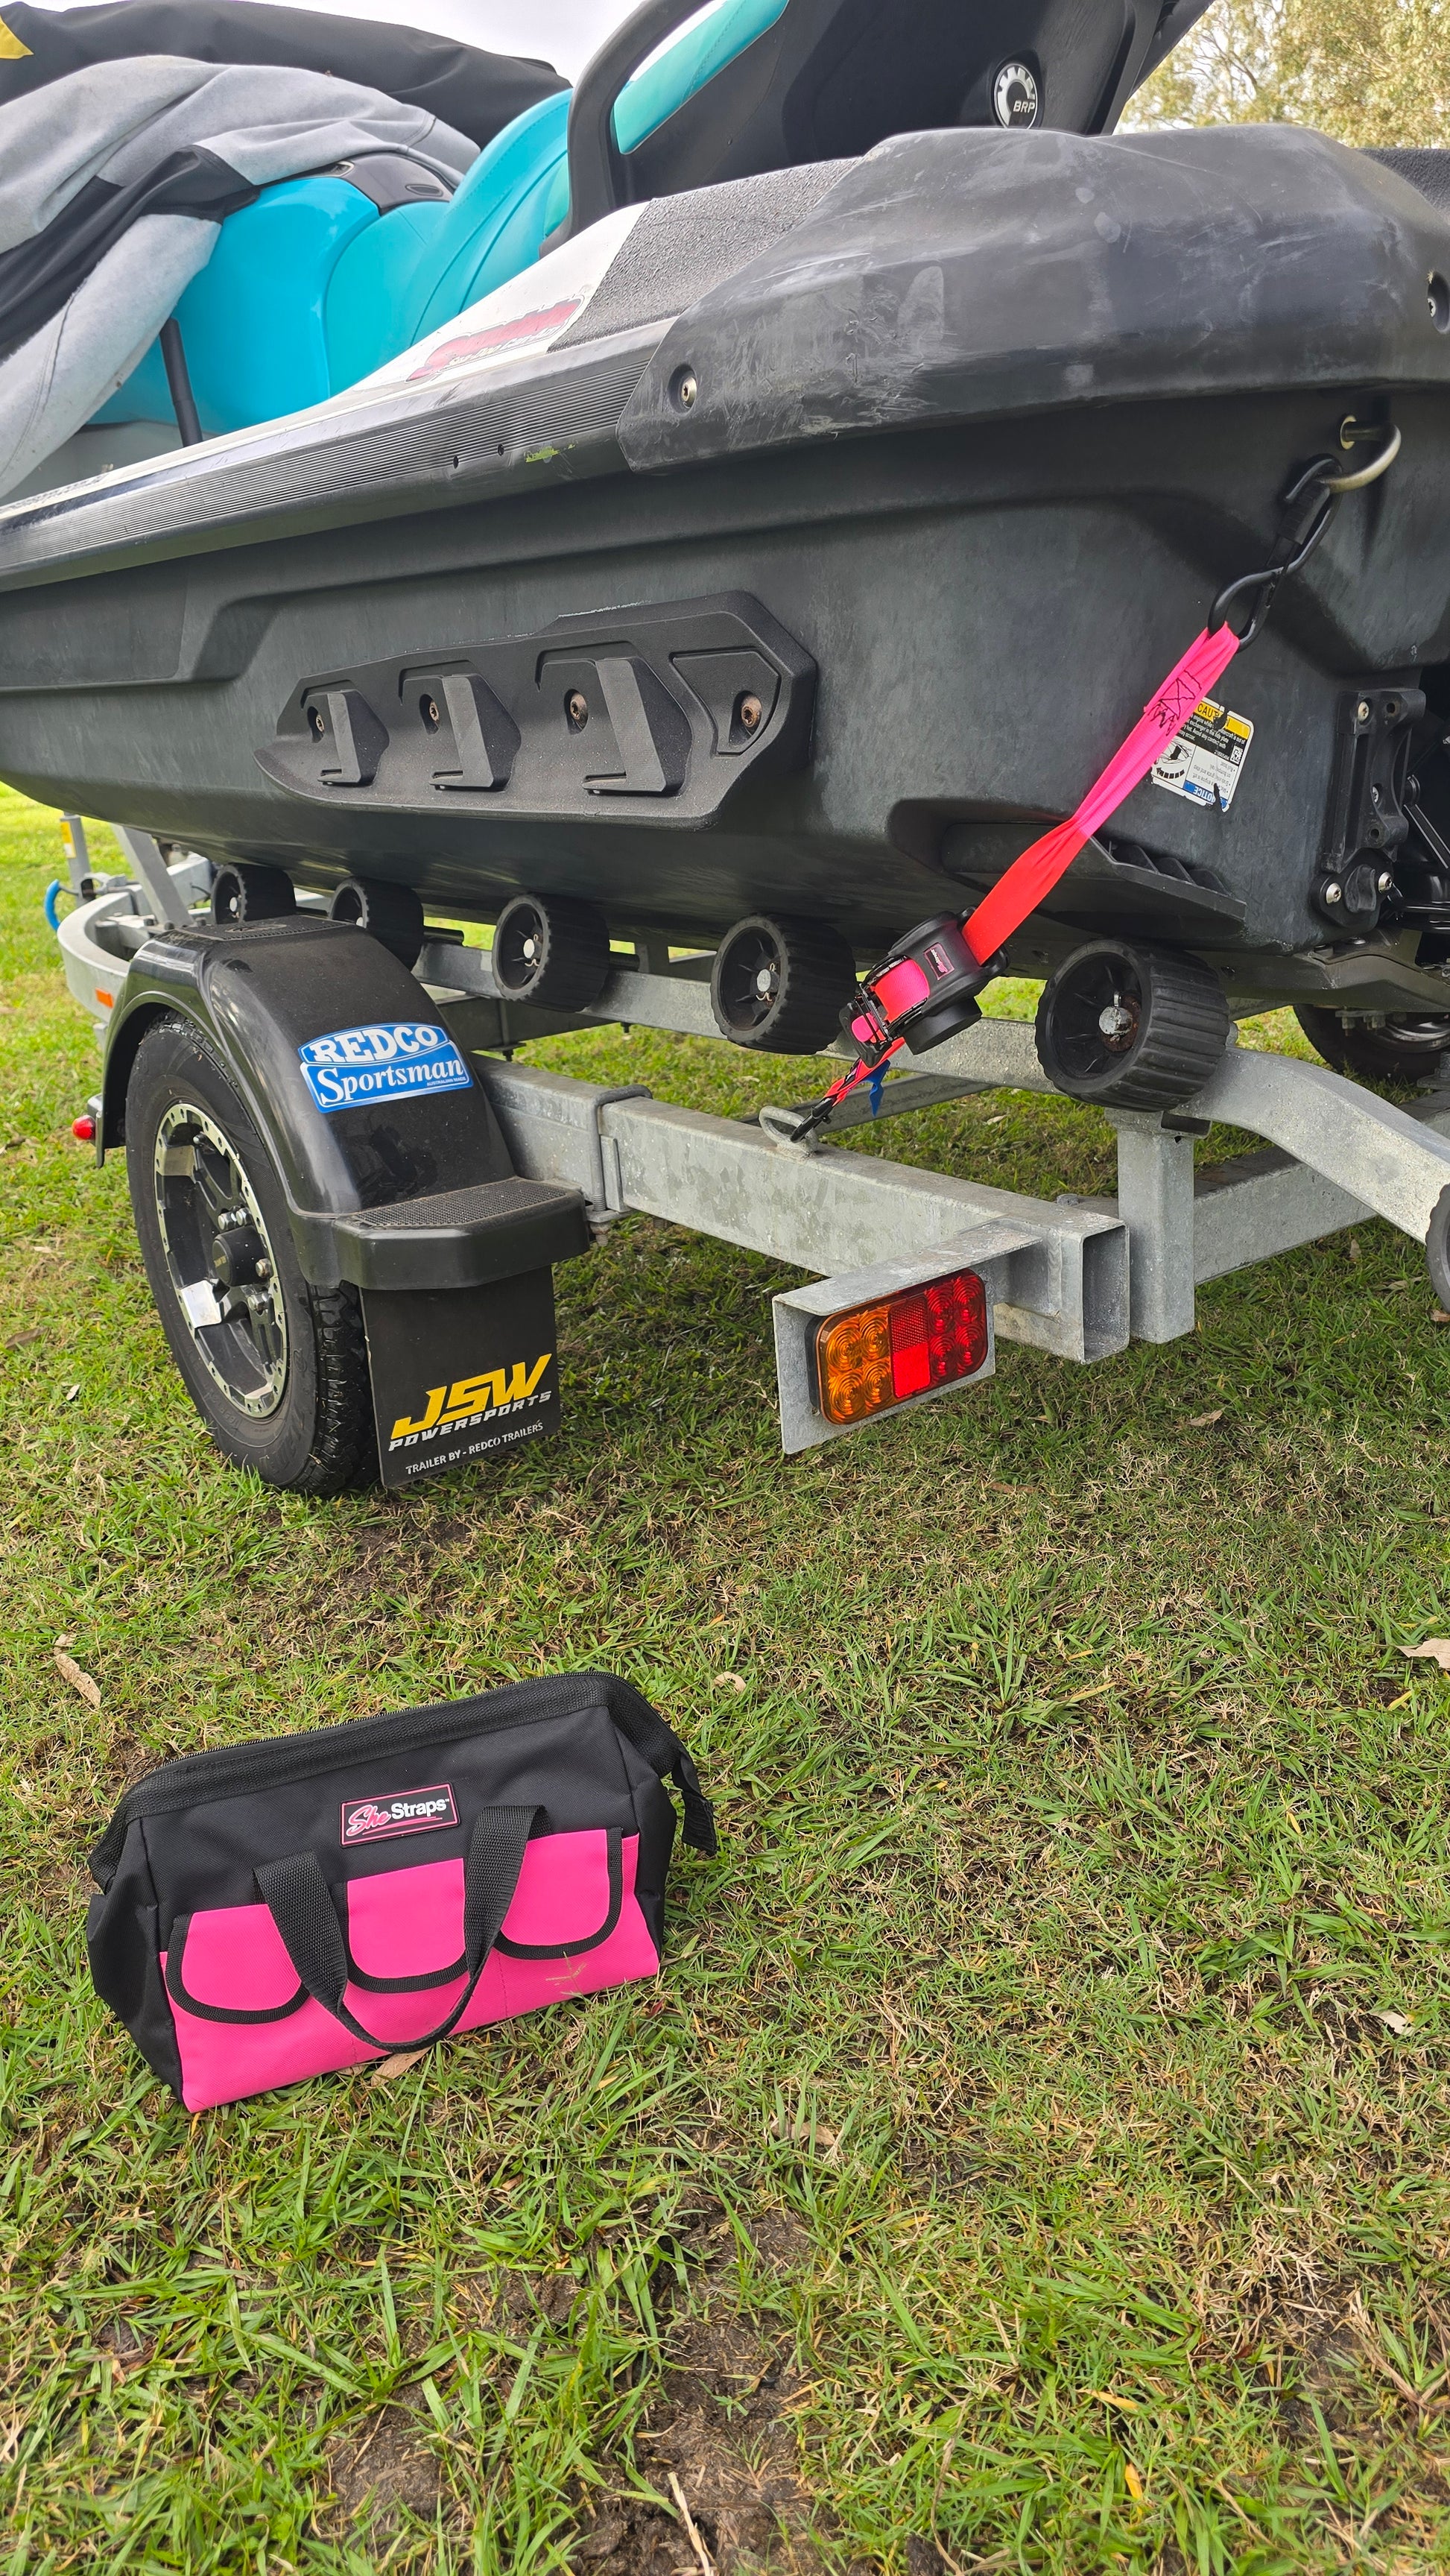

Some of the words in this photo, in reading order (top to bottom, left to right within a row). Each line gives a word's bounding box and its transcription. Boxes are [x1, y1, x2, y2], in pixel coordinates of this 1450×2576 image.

[1013, 100, 1035, 113] BRP
[309, 1026, 438, 1063] REDCO
[317, 1059, 464, 1104] Sportsman
[390, 1353, 552, 1440] JSW
[388, 1391, 552, 1452] POWERSPORTS
[405, 1455, 447, 1474] TRAILER
[449, 1449, 460, 1462] BY
[469, 1437, 501, 1454] REDCO
[501, 1422, 544, 1443] TRAILERS
[346, 1804, 392, 1837] She
